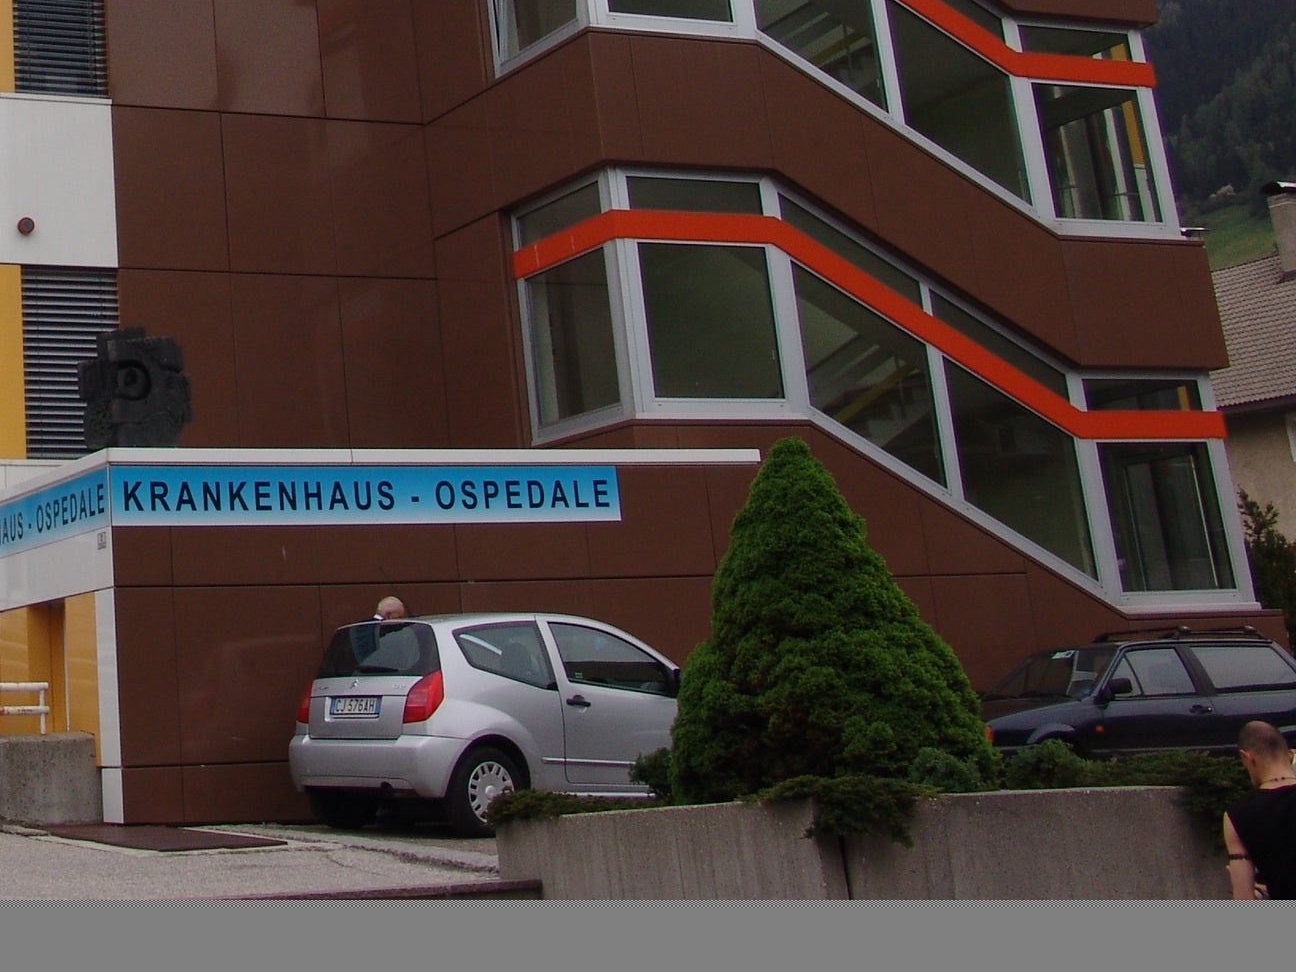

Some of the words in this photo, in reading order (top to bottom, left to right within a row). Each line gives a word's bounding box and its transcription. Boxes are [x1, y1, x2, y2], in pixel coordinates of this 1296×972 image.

[36, 483, 105, 533] OSPEDALE
[123, 479, 396, 513] KRANKENHAUS
[434, 478, 611, 510] OSPEDALE
